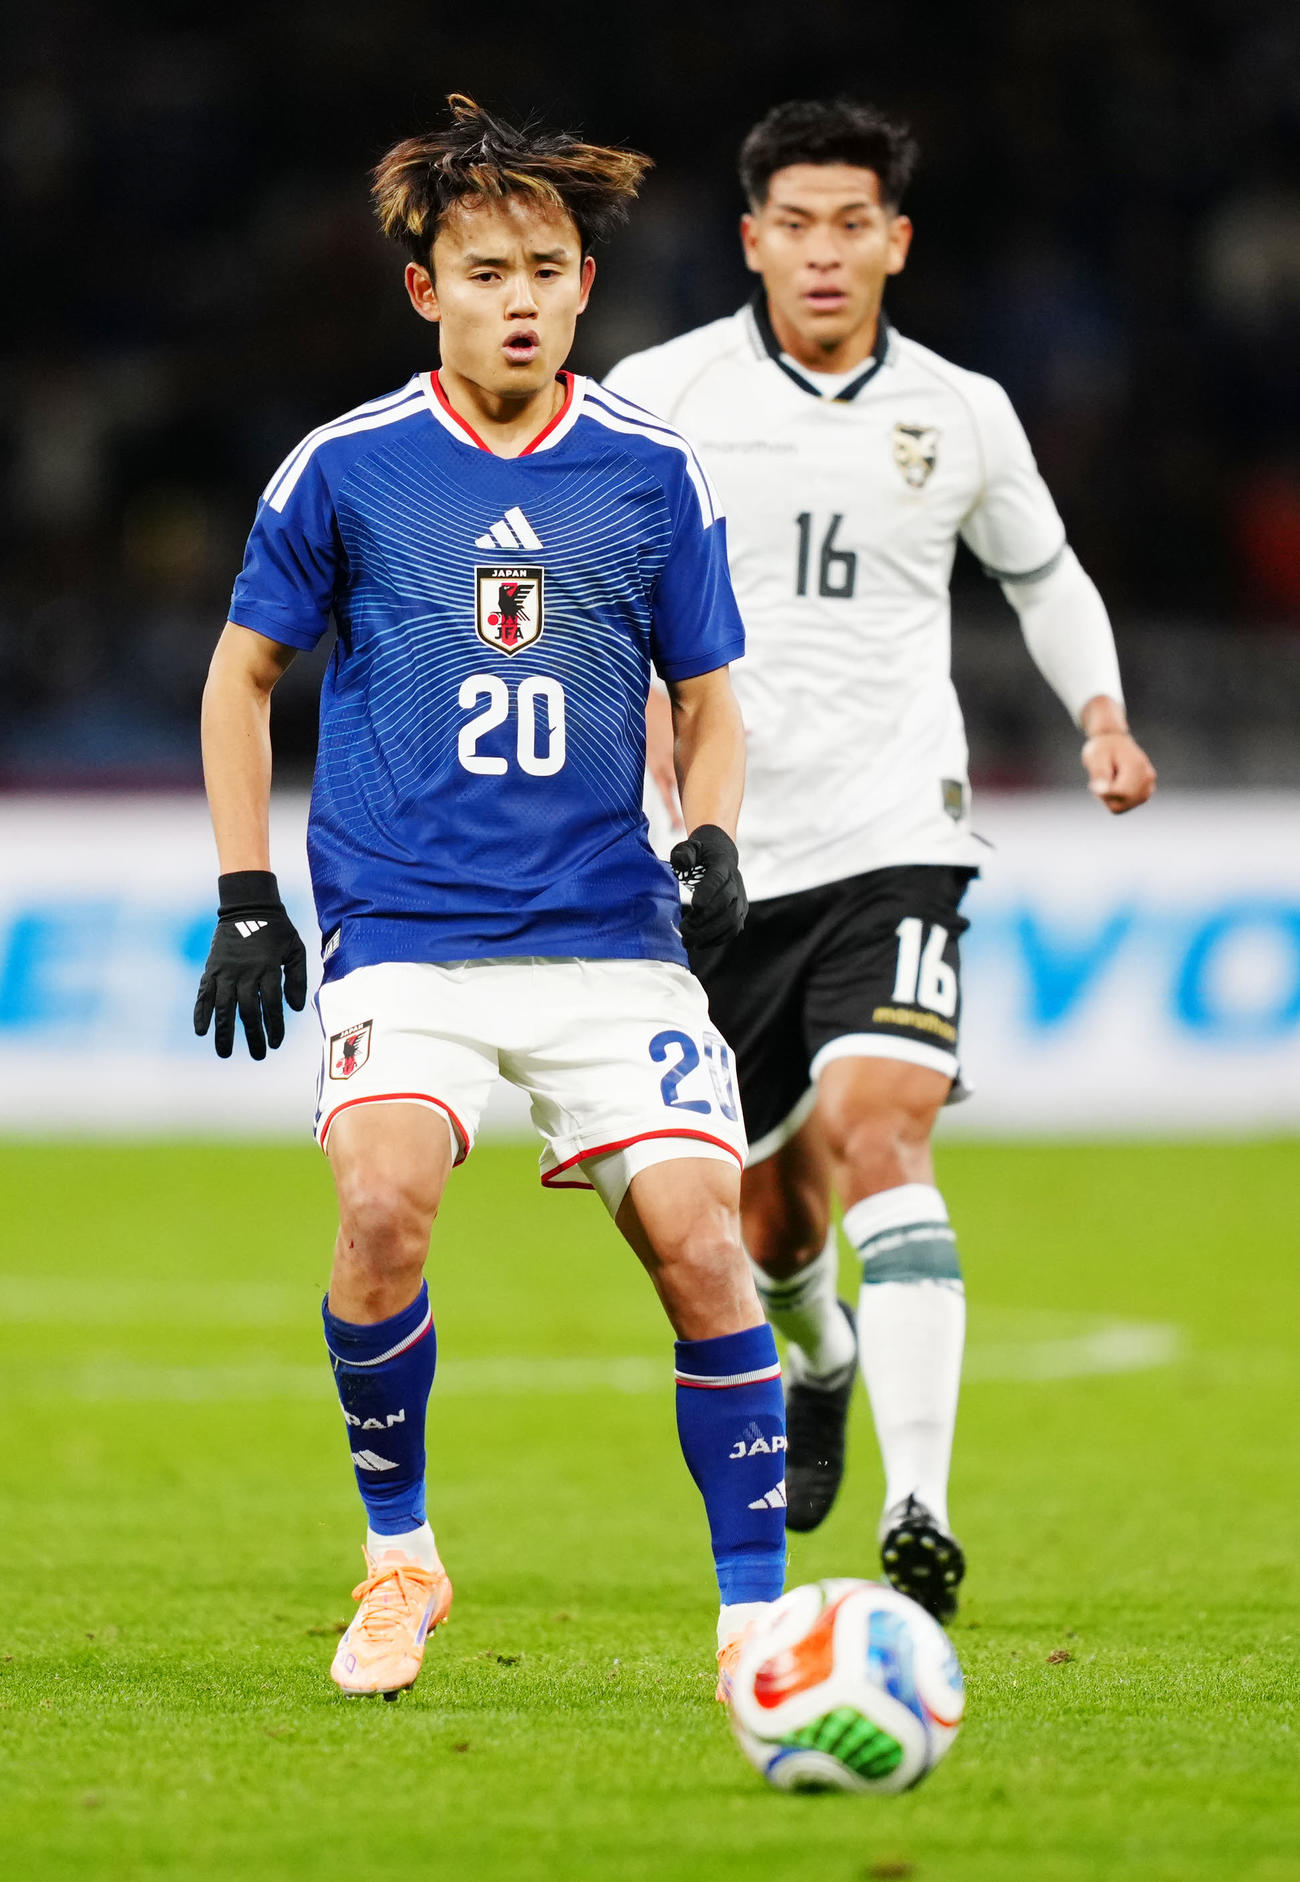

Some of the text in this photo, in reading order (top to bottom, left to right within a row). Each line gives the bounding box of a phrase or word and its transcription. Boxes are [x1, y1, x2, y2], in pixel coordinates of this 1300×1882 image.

[491, 569, 527, 577] JAPAN
[796, 512, 857, 598] 16
[494, 627, 524, 640] JFA
[458, 673, 566, 777] 20
[892, 916, 958, 1018] 16
[340, 1023, 364, 1037] JAPAN
[648, 1030, 738, 1122] 20
[728, 1435, 788, 1459] JAP
